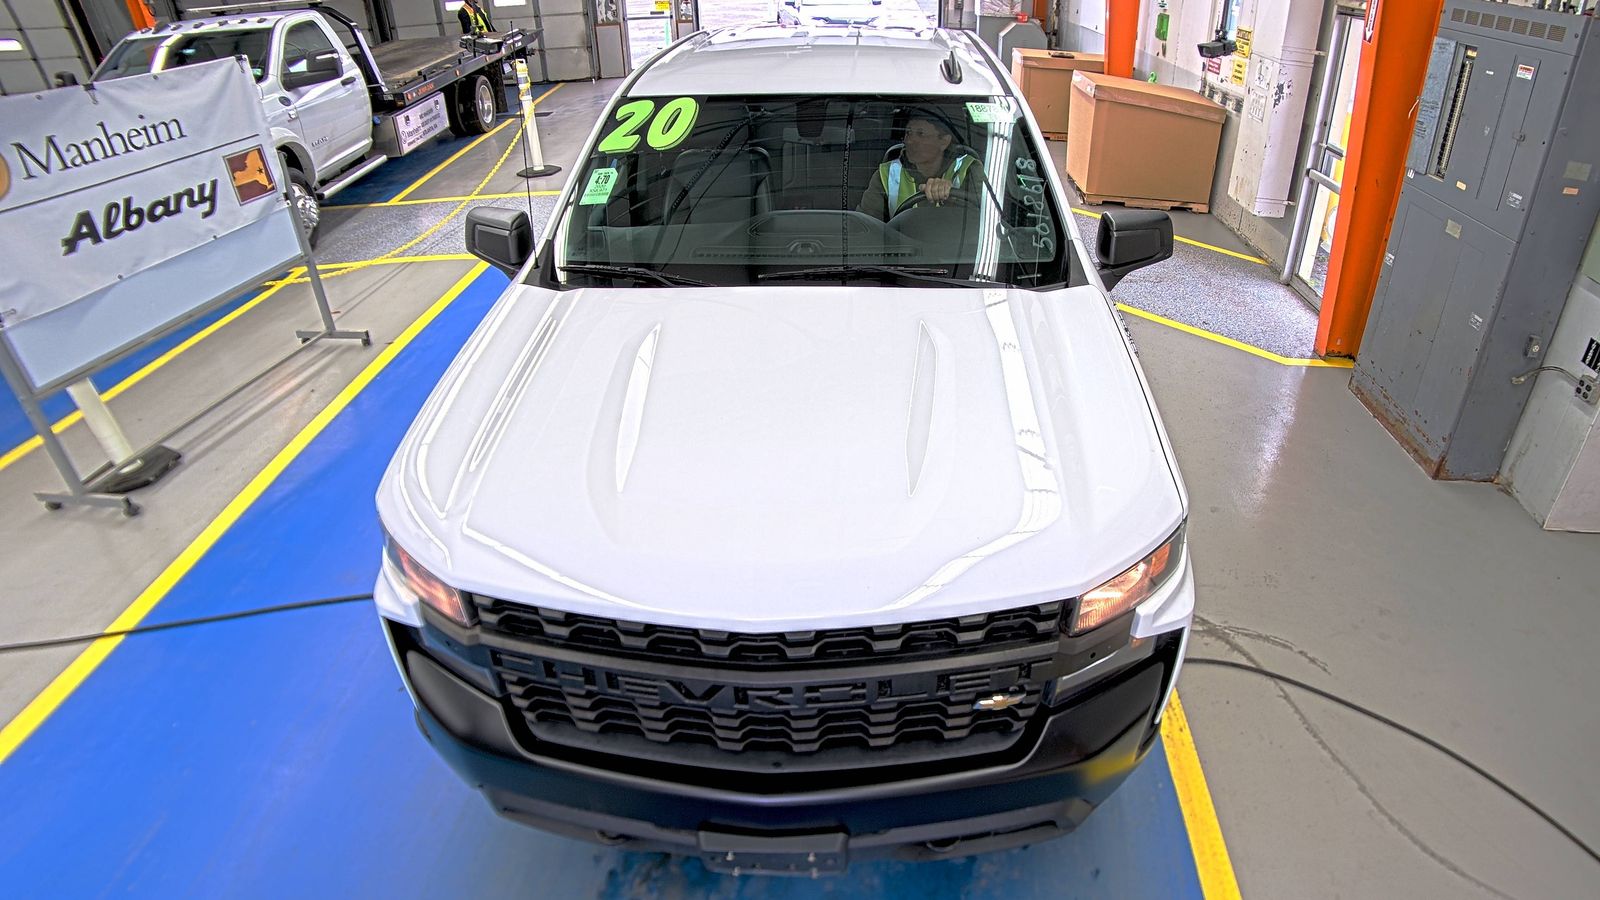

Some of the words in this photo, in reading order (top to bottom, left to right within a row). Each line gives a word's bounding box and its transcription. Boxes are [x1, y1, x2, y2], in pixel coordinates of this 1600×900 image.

[11, 116, 188, 180] Manheim
[598, 97, 699, 153] 20
[61, 178, 218, 256] Albany
[489, 649, 1053, 710] CHEVROLET
